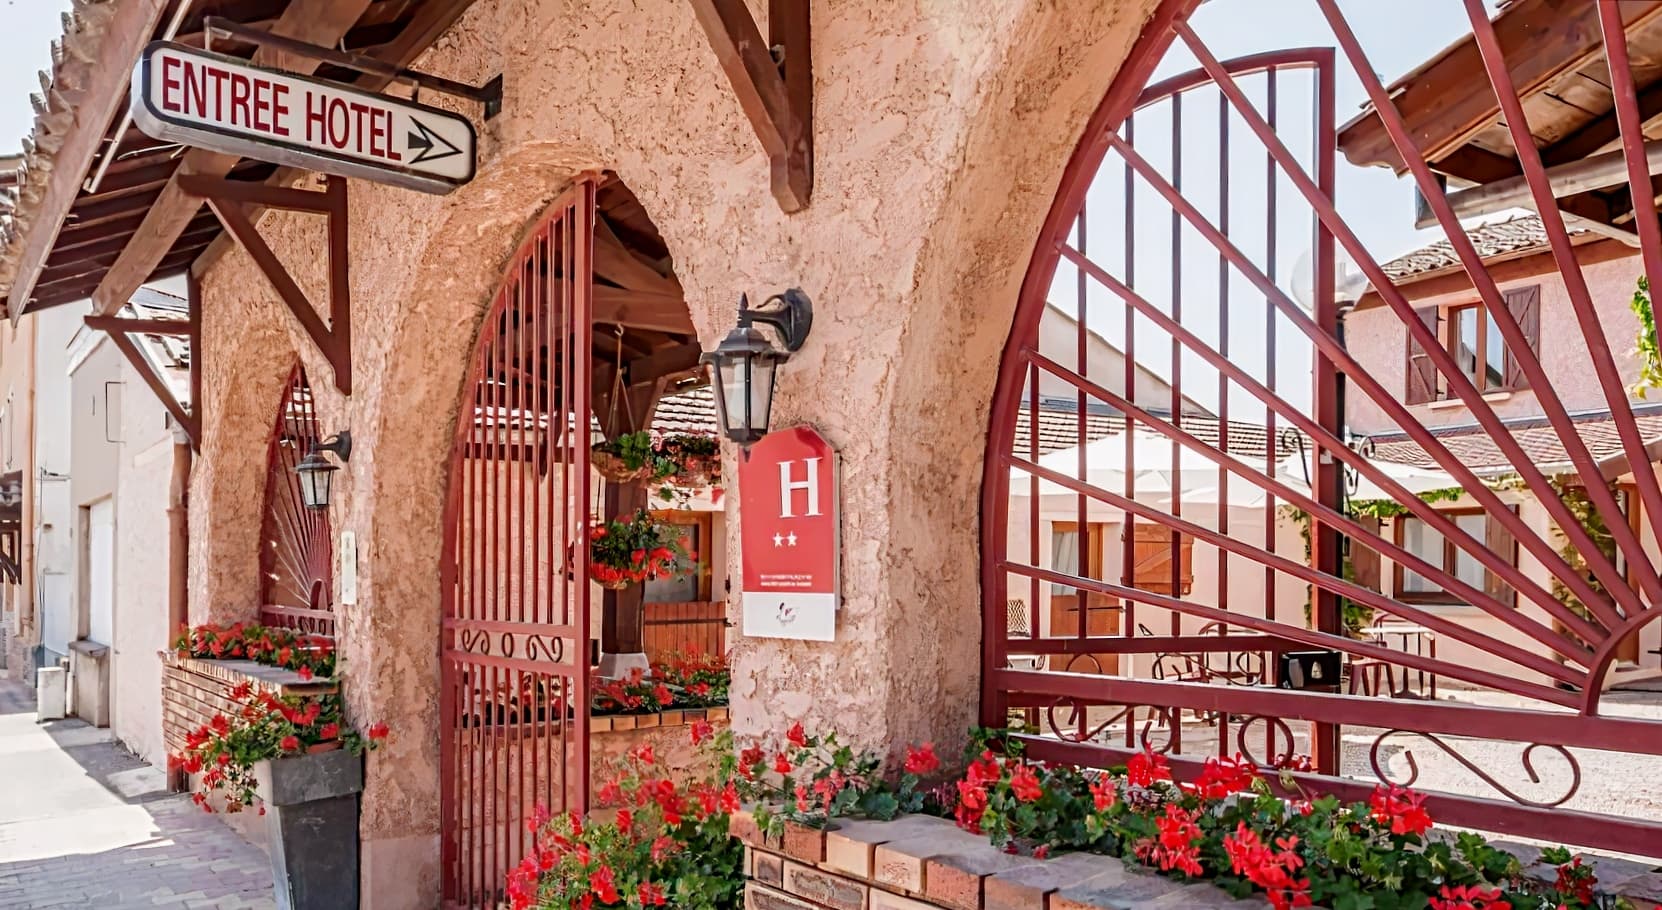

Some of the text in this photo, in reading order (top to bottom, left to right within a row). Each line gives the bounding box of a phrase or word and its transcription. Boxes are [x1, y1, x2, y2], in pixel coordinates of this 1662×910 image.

[162, 56, 402, 161] ENTREE HOTEL
[776, 456, 824, 518] H
